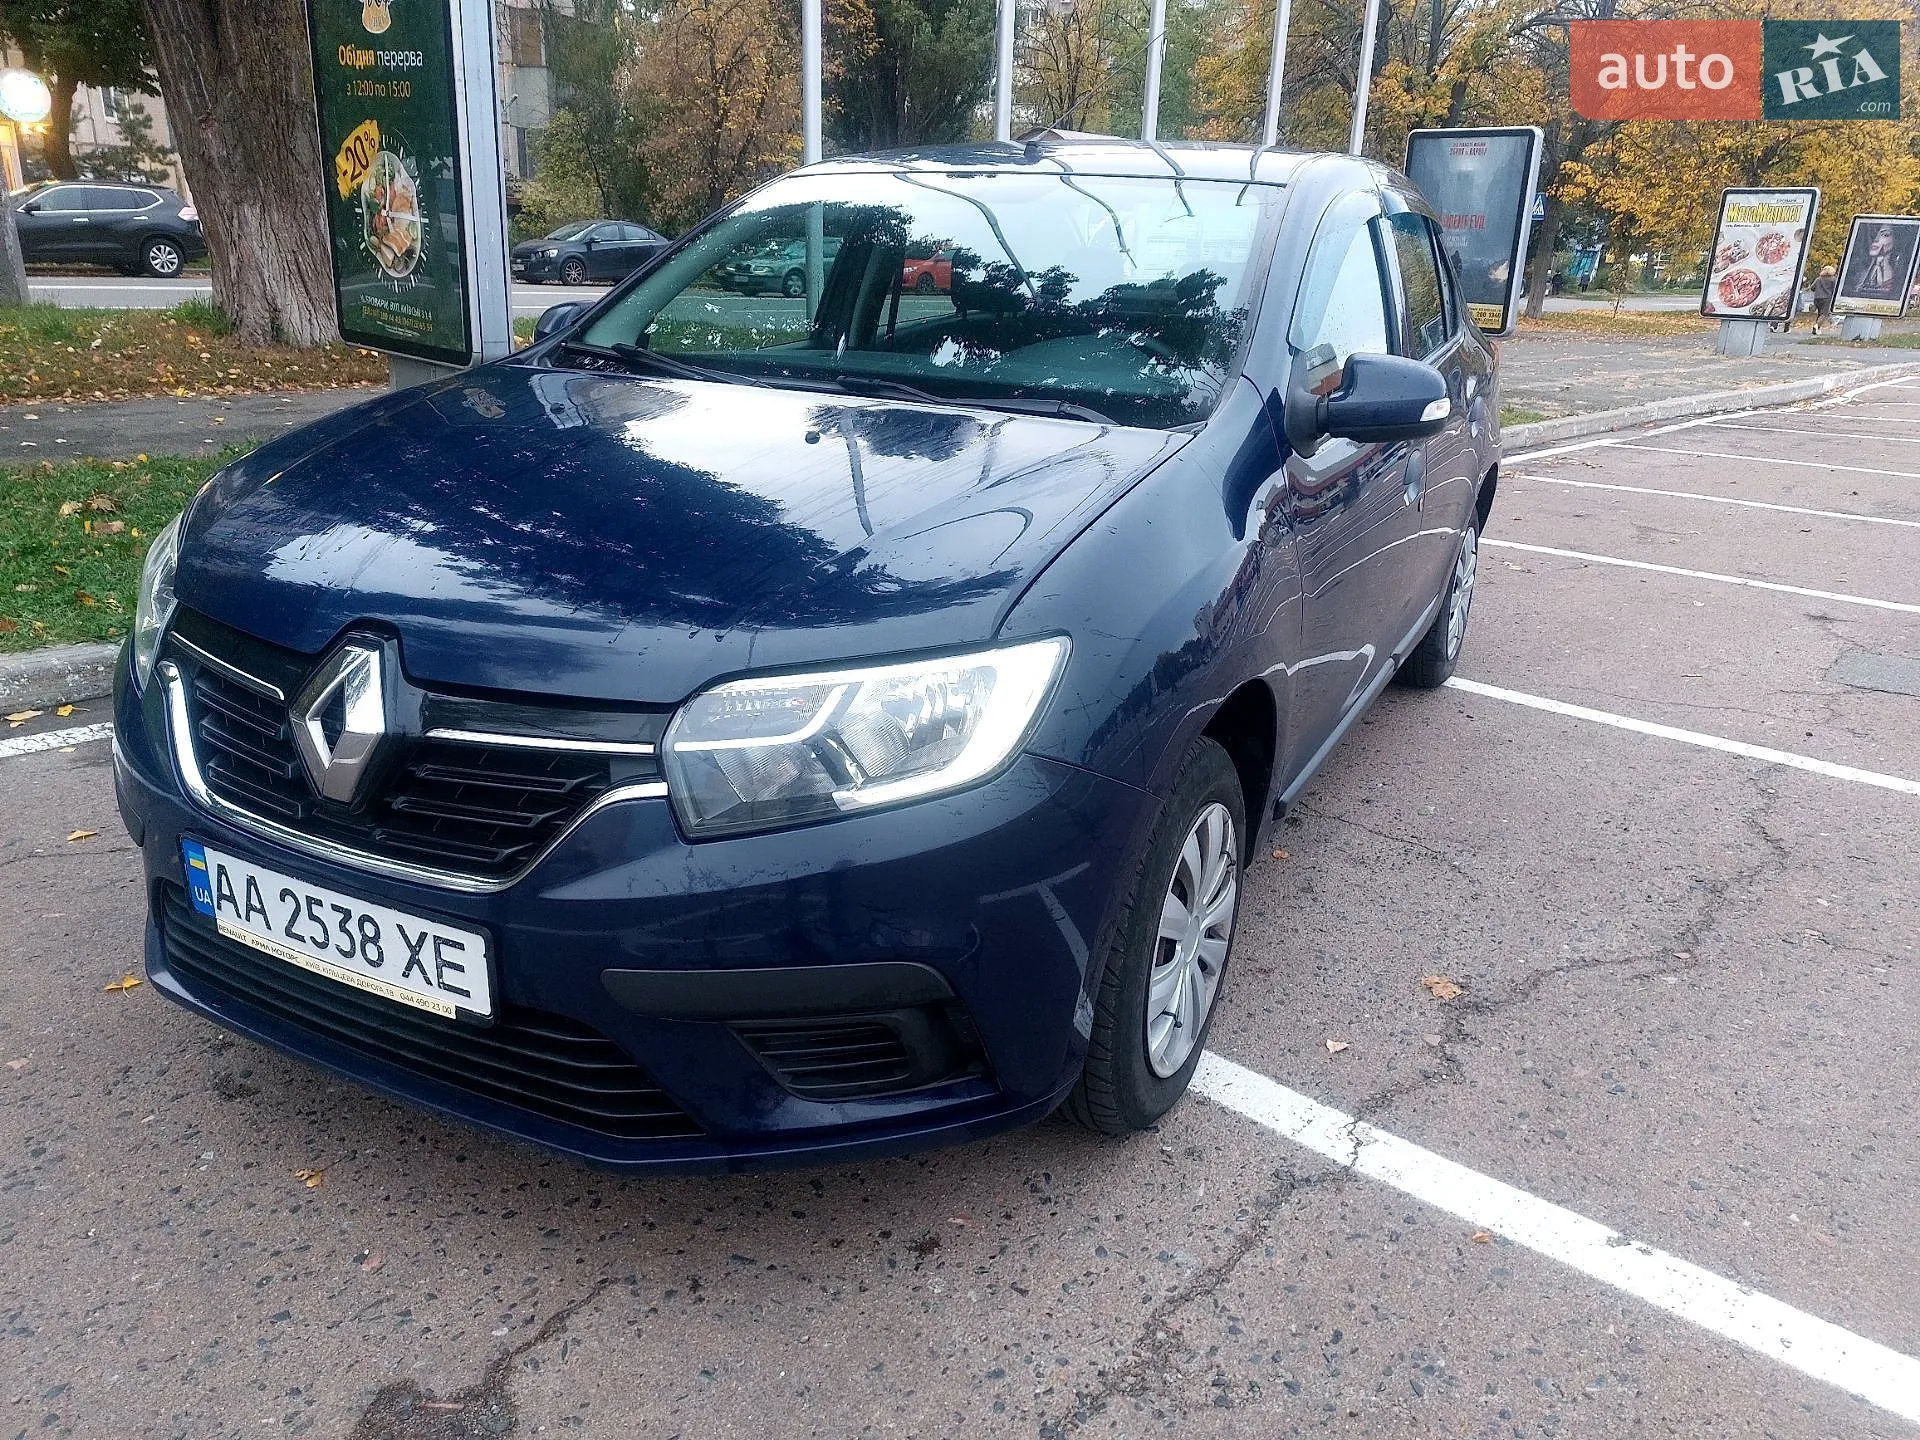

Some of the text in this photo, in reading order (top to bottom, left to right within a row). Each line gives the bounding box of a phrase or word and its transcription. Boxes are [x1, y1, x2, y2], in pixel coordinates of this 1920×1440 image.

[338, 43, 423, 72] Обідня перерва
[353, 80, 373, 97] 12:00
[375, 84, 385, 97] по
[388, 80, 411, 98] 15:00
[342, 126, 376, 182] -20%
[194, 885, 212, 906] UA
[216, 863, 471, 999] AA 2538 XE
